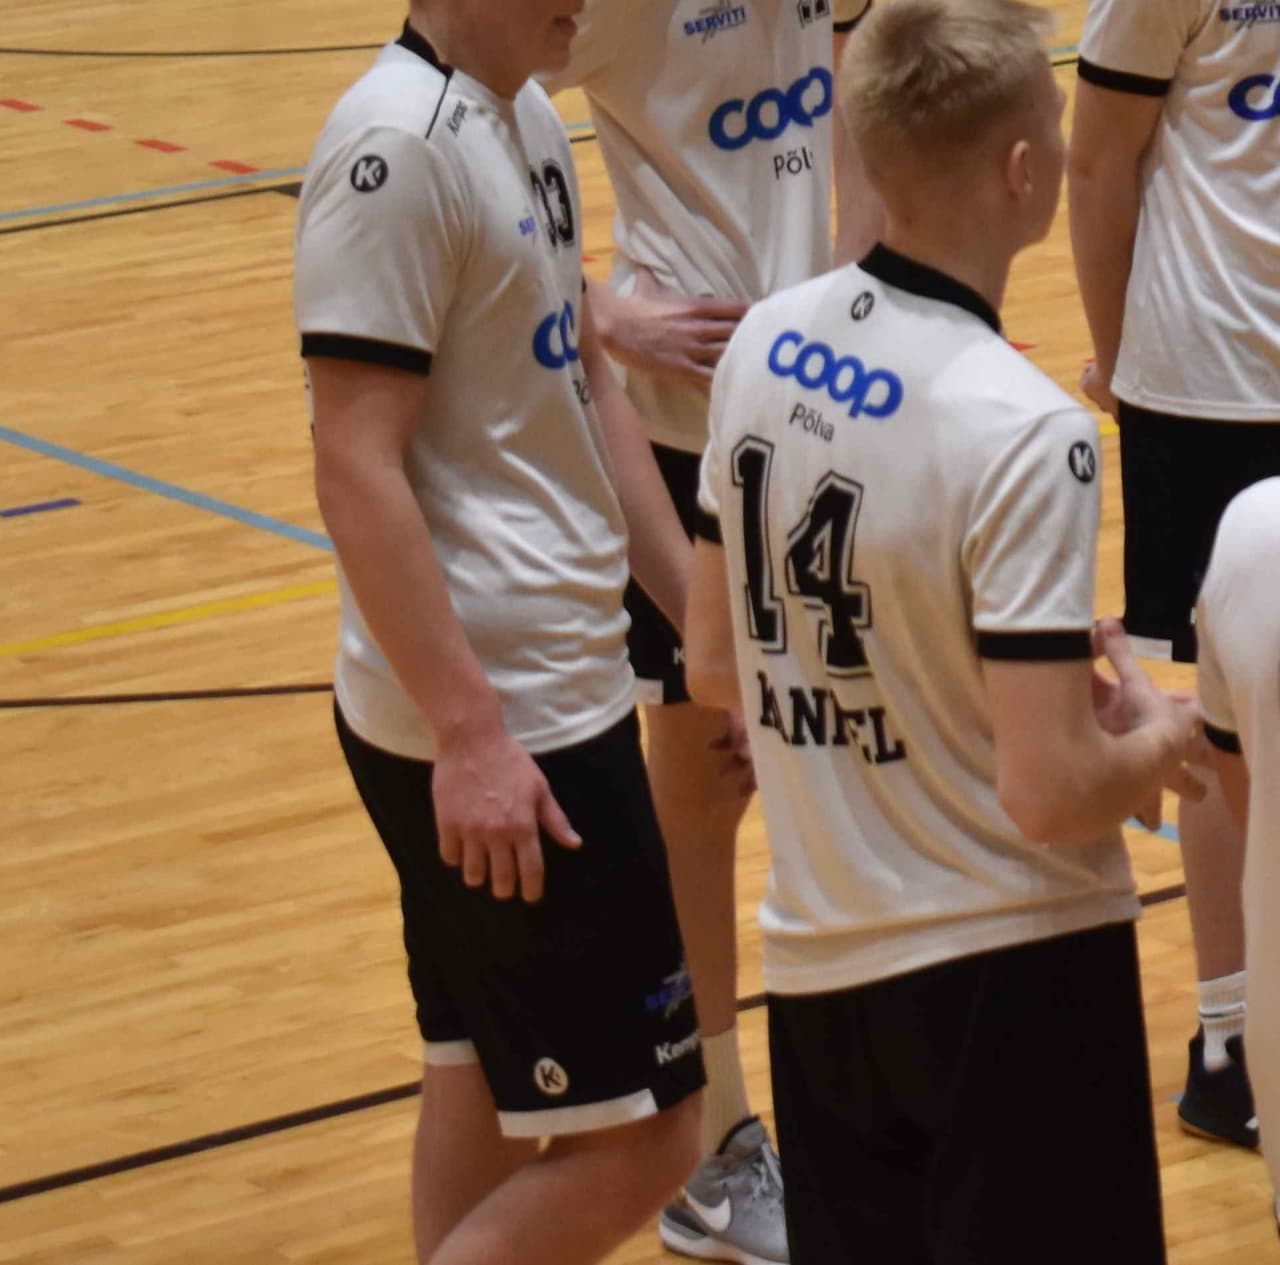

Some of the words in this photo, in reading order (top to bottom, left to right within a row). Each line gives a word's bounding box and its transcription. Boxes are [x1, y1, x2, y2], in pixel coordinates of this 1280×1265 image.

[767, 330, 903, 420] coop
[789, 401, 836, 442] Põlva
[731, 433, 873, 679] 14
